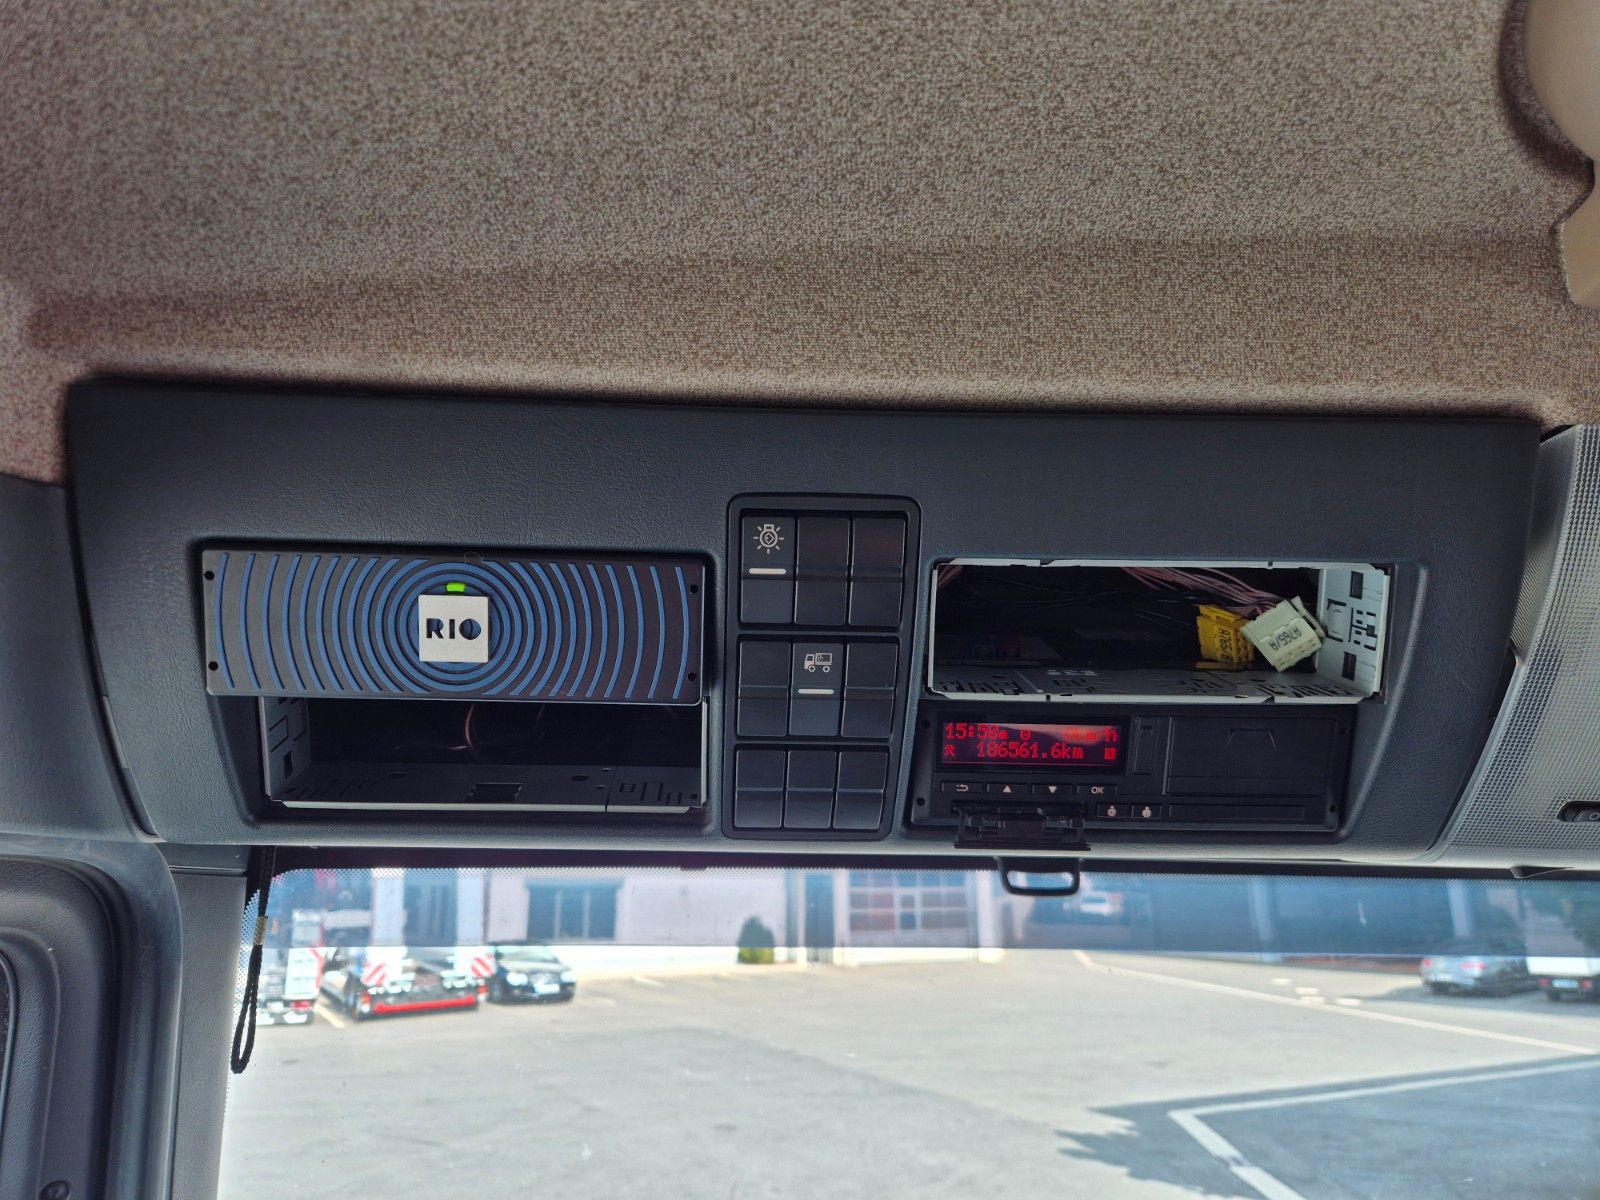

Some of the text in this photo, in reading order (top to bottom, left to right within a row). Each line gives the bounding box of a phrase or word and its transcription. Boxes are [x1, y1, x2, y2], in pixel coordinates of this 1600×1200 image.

[426, 618, 481, 640] RIO
[1268, 626, 1302, 651] A765/A
[1091, 786, 1104, 795] OK
